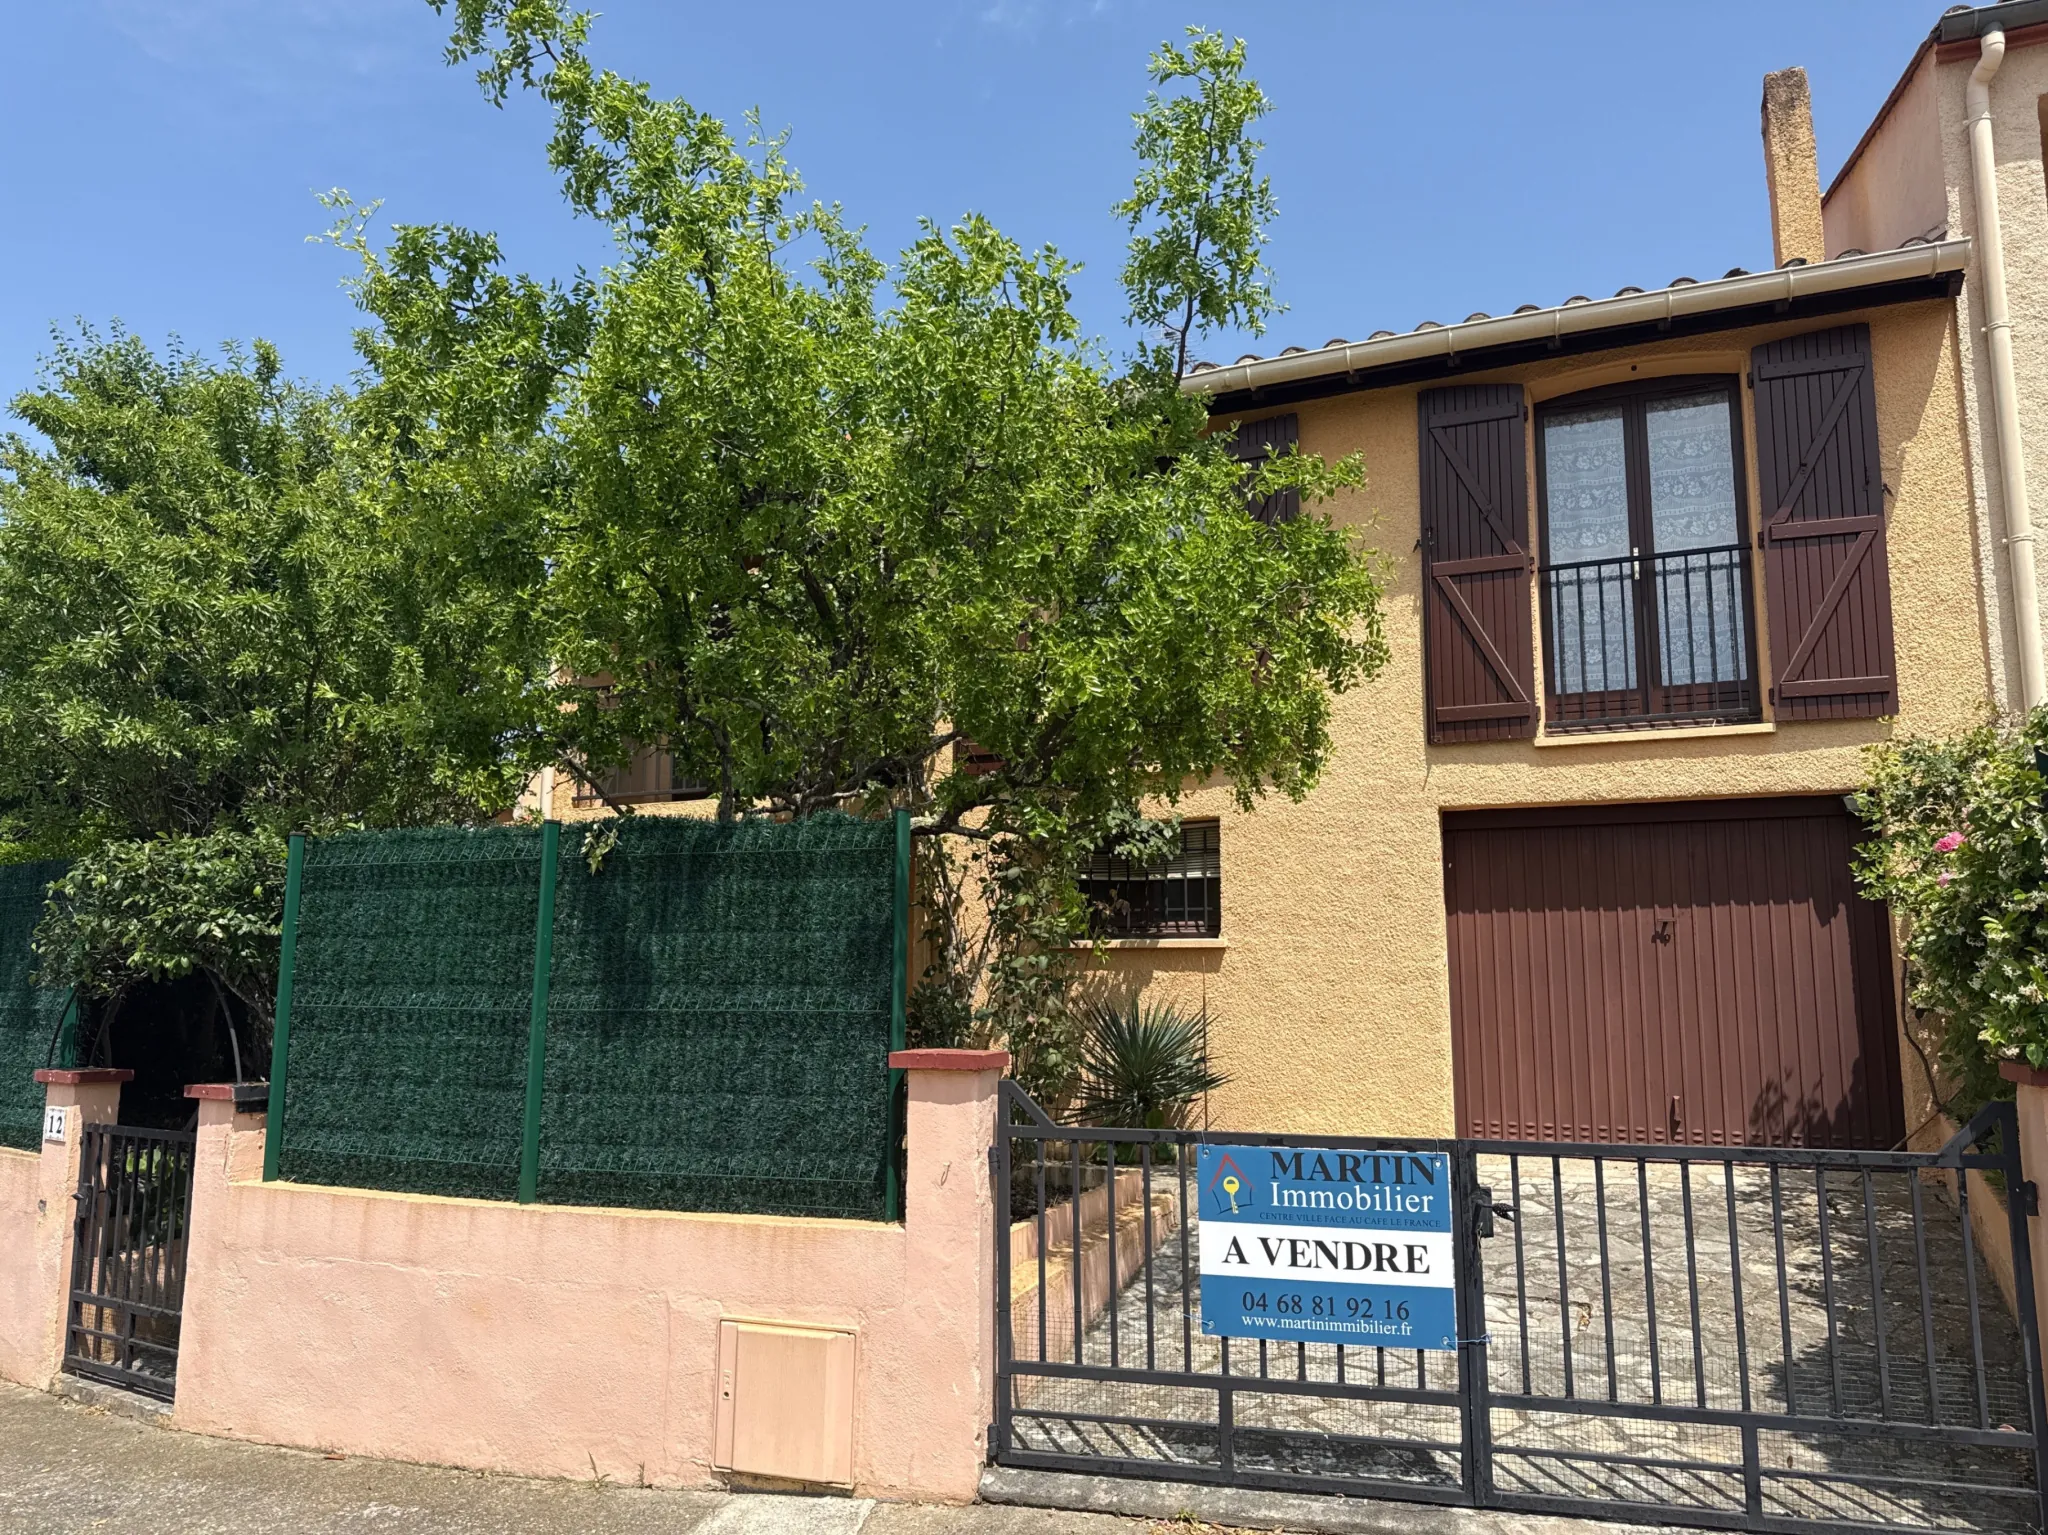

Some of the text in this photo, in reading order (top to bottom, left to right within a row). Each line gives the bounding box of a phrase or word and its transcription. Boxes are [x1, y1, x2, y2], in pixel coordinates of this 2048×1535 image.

[49, 1115, 63, 1134] 12
[1270, 1151, 1435, 1186] MARTIN
[1270, 1182, 1434, 1213] Immobilier
[1259, 1212, 1294, 1221] CENTRE
[1296, 1214, 1323, 1223] VILLE
[1324, 1215, 1347, 1224] FACE
[1348, 1217, 1362, 1225] AU
[1364, 1217, 1388, 1226] CAFE
[1404, 1220, 1441, 1228] FRANCE
[1221, 1235, 1430, 1274] A VENDRE
[1242, 1291, 1410, 1321] 04 68 81 92 16
